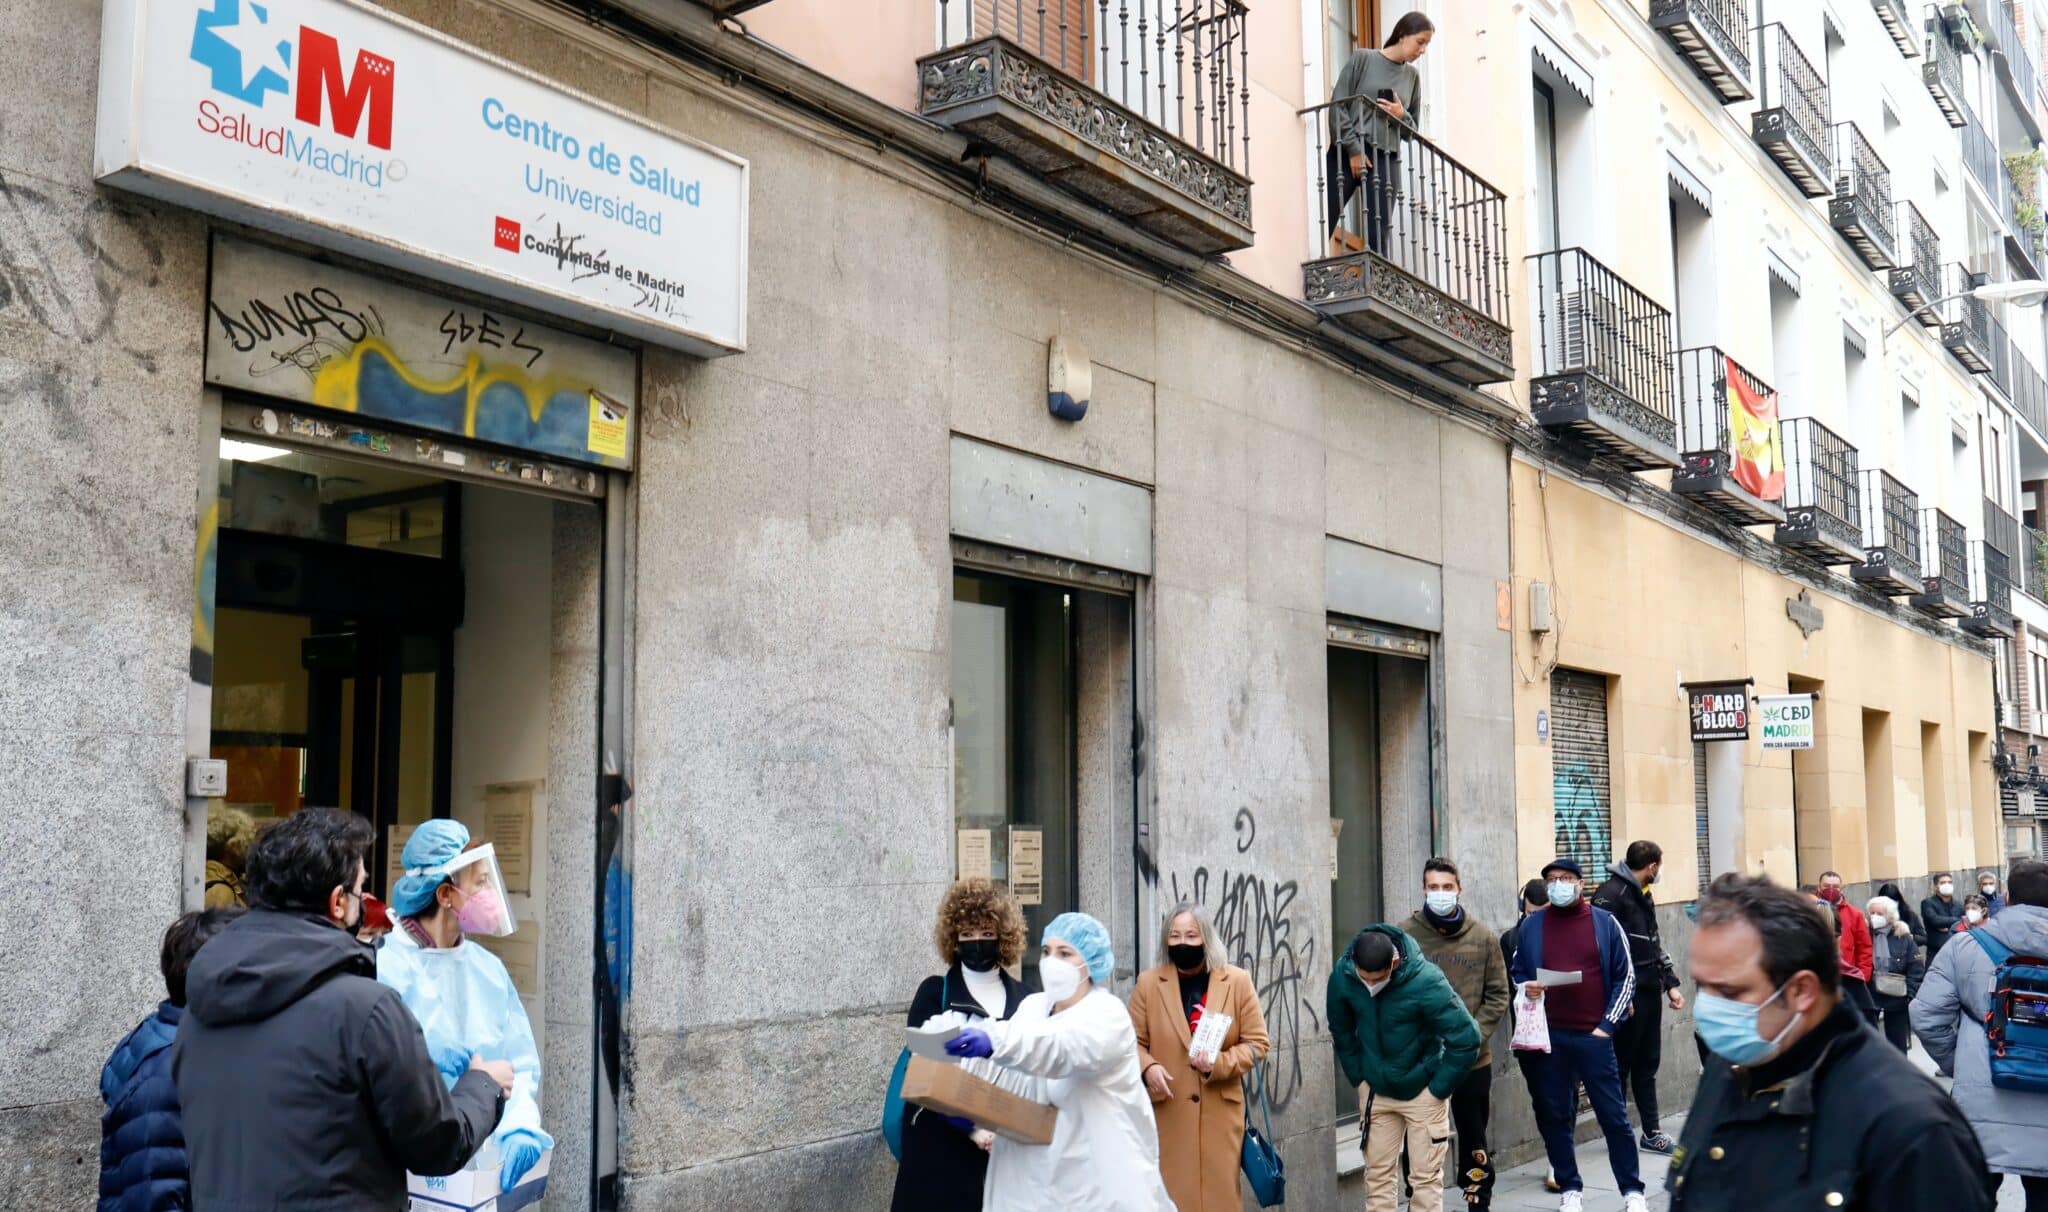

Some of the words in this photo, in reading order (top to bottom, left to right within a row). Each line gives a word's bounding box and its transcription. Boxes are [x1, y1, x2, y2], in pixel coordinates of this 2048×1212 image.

[295, 24, 395, 151] M
[197, 99, 383, 188] SaludMadrid
[481, 97, 580, 160] Centro
[588, 142, 621, 176] de
[629, 154, 700, 208] Salud
[525, 163, 662, 236] Universidad
[614, 264, 633, 281] de
[637, 270, 685, 298] Madrid
[1702, 694, 1745, 712] HARD
[1702, 711, 1746, 729] BLOOD
[1781, 705, 1811, 721] CBD
[1763, 724, 1811, 738] MADRID
